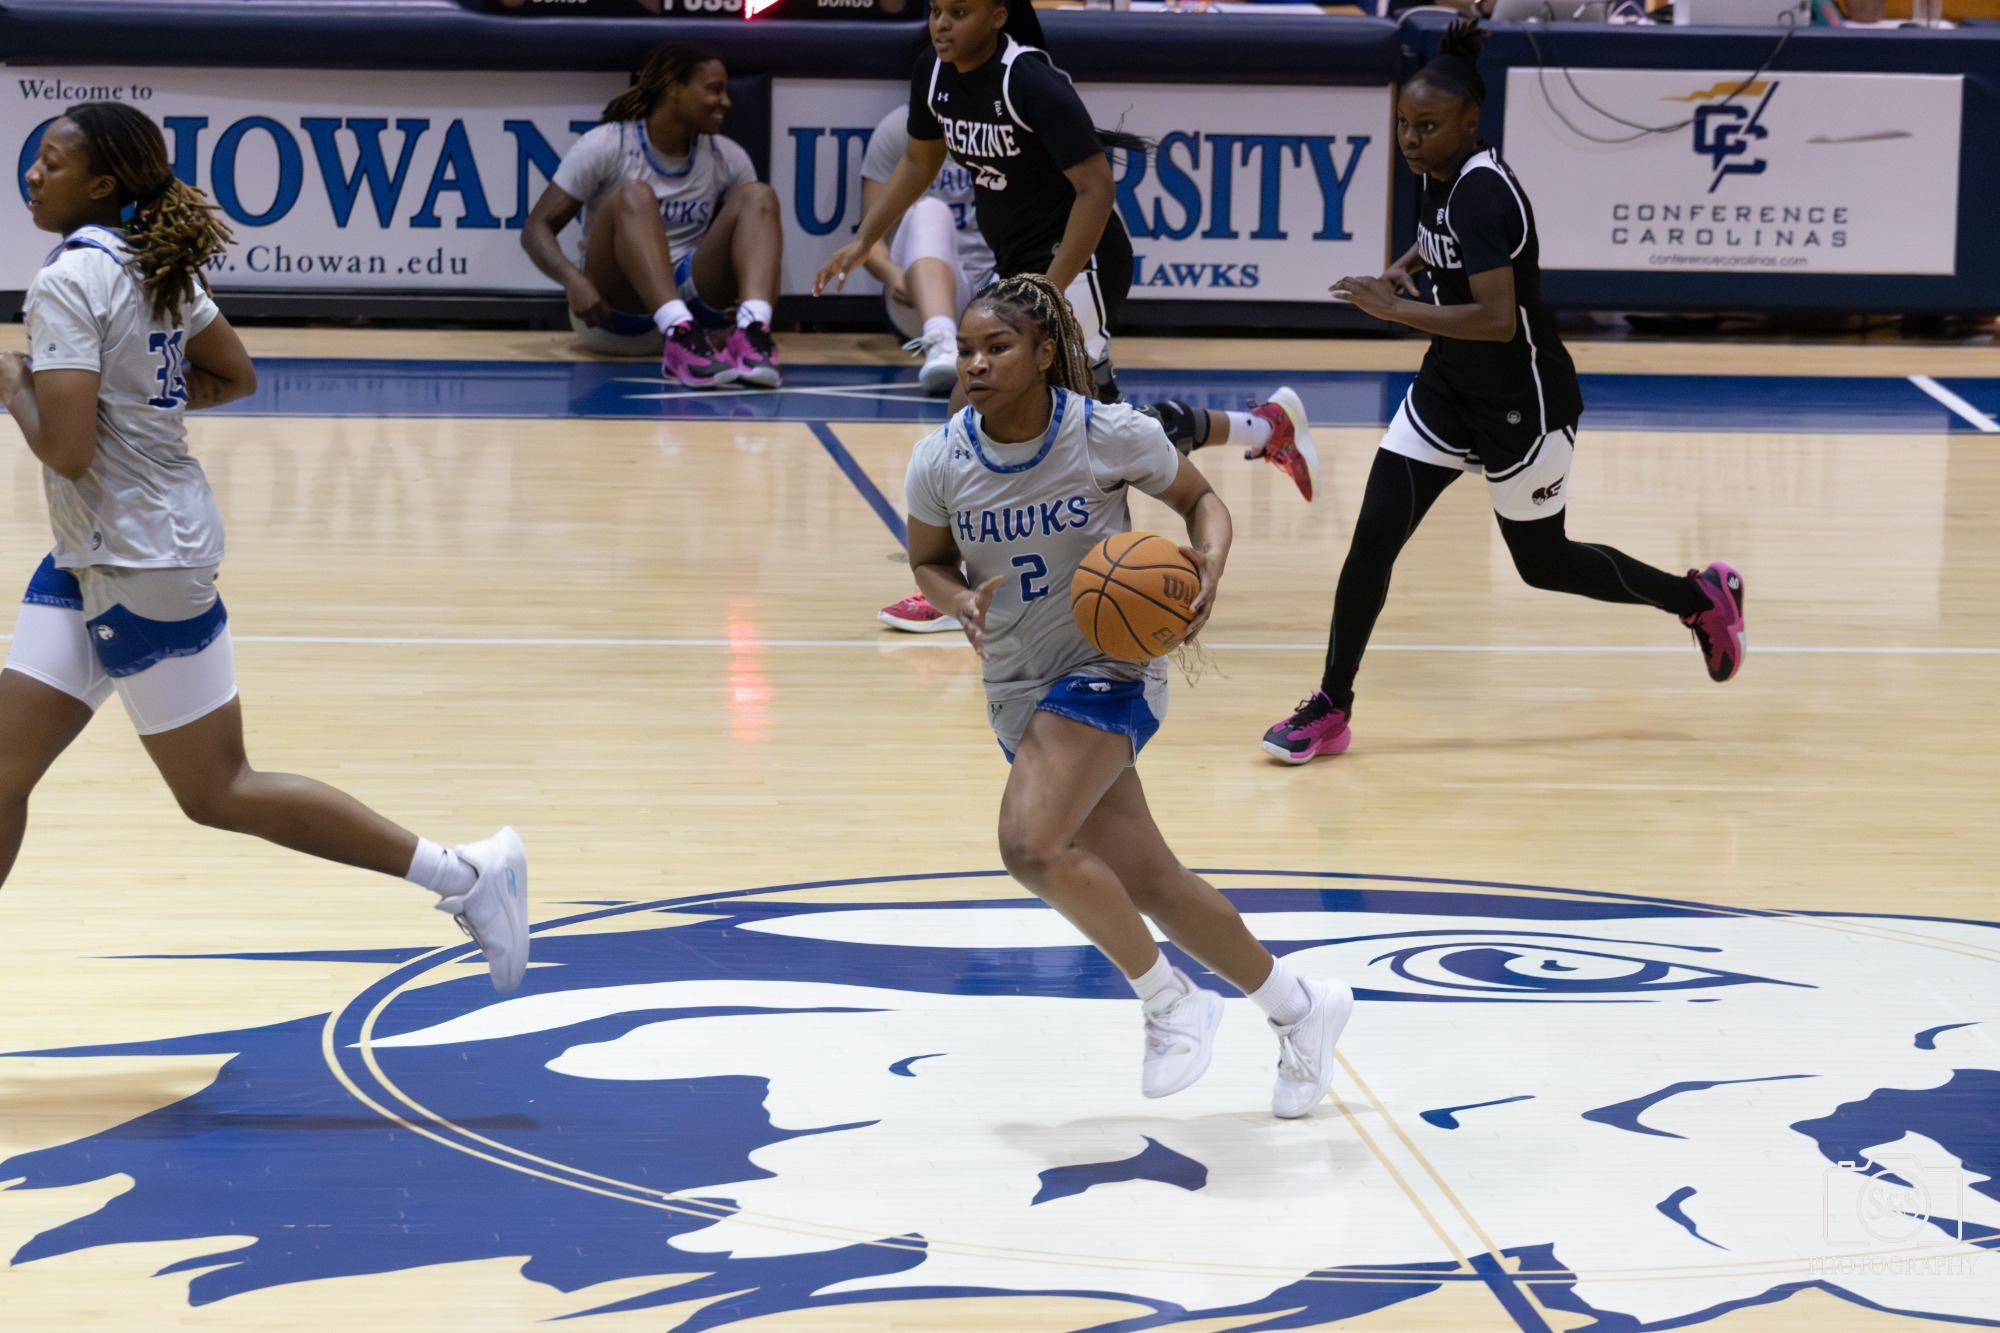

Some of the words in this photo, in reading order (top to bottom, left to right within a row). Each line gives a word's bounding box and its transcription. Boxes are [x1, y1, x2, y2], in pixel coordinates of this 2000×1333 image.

[18, 79, 124, 100] Welcome
[131, 84, 153, 100] to
[1612, 203, 1849, 224] CONFERENCE
[1611, 227, 1848, 248] CAROLINAS
[956, 496, 1091, 544] HAWKS
[1010, 553, 1050, 602] 2
